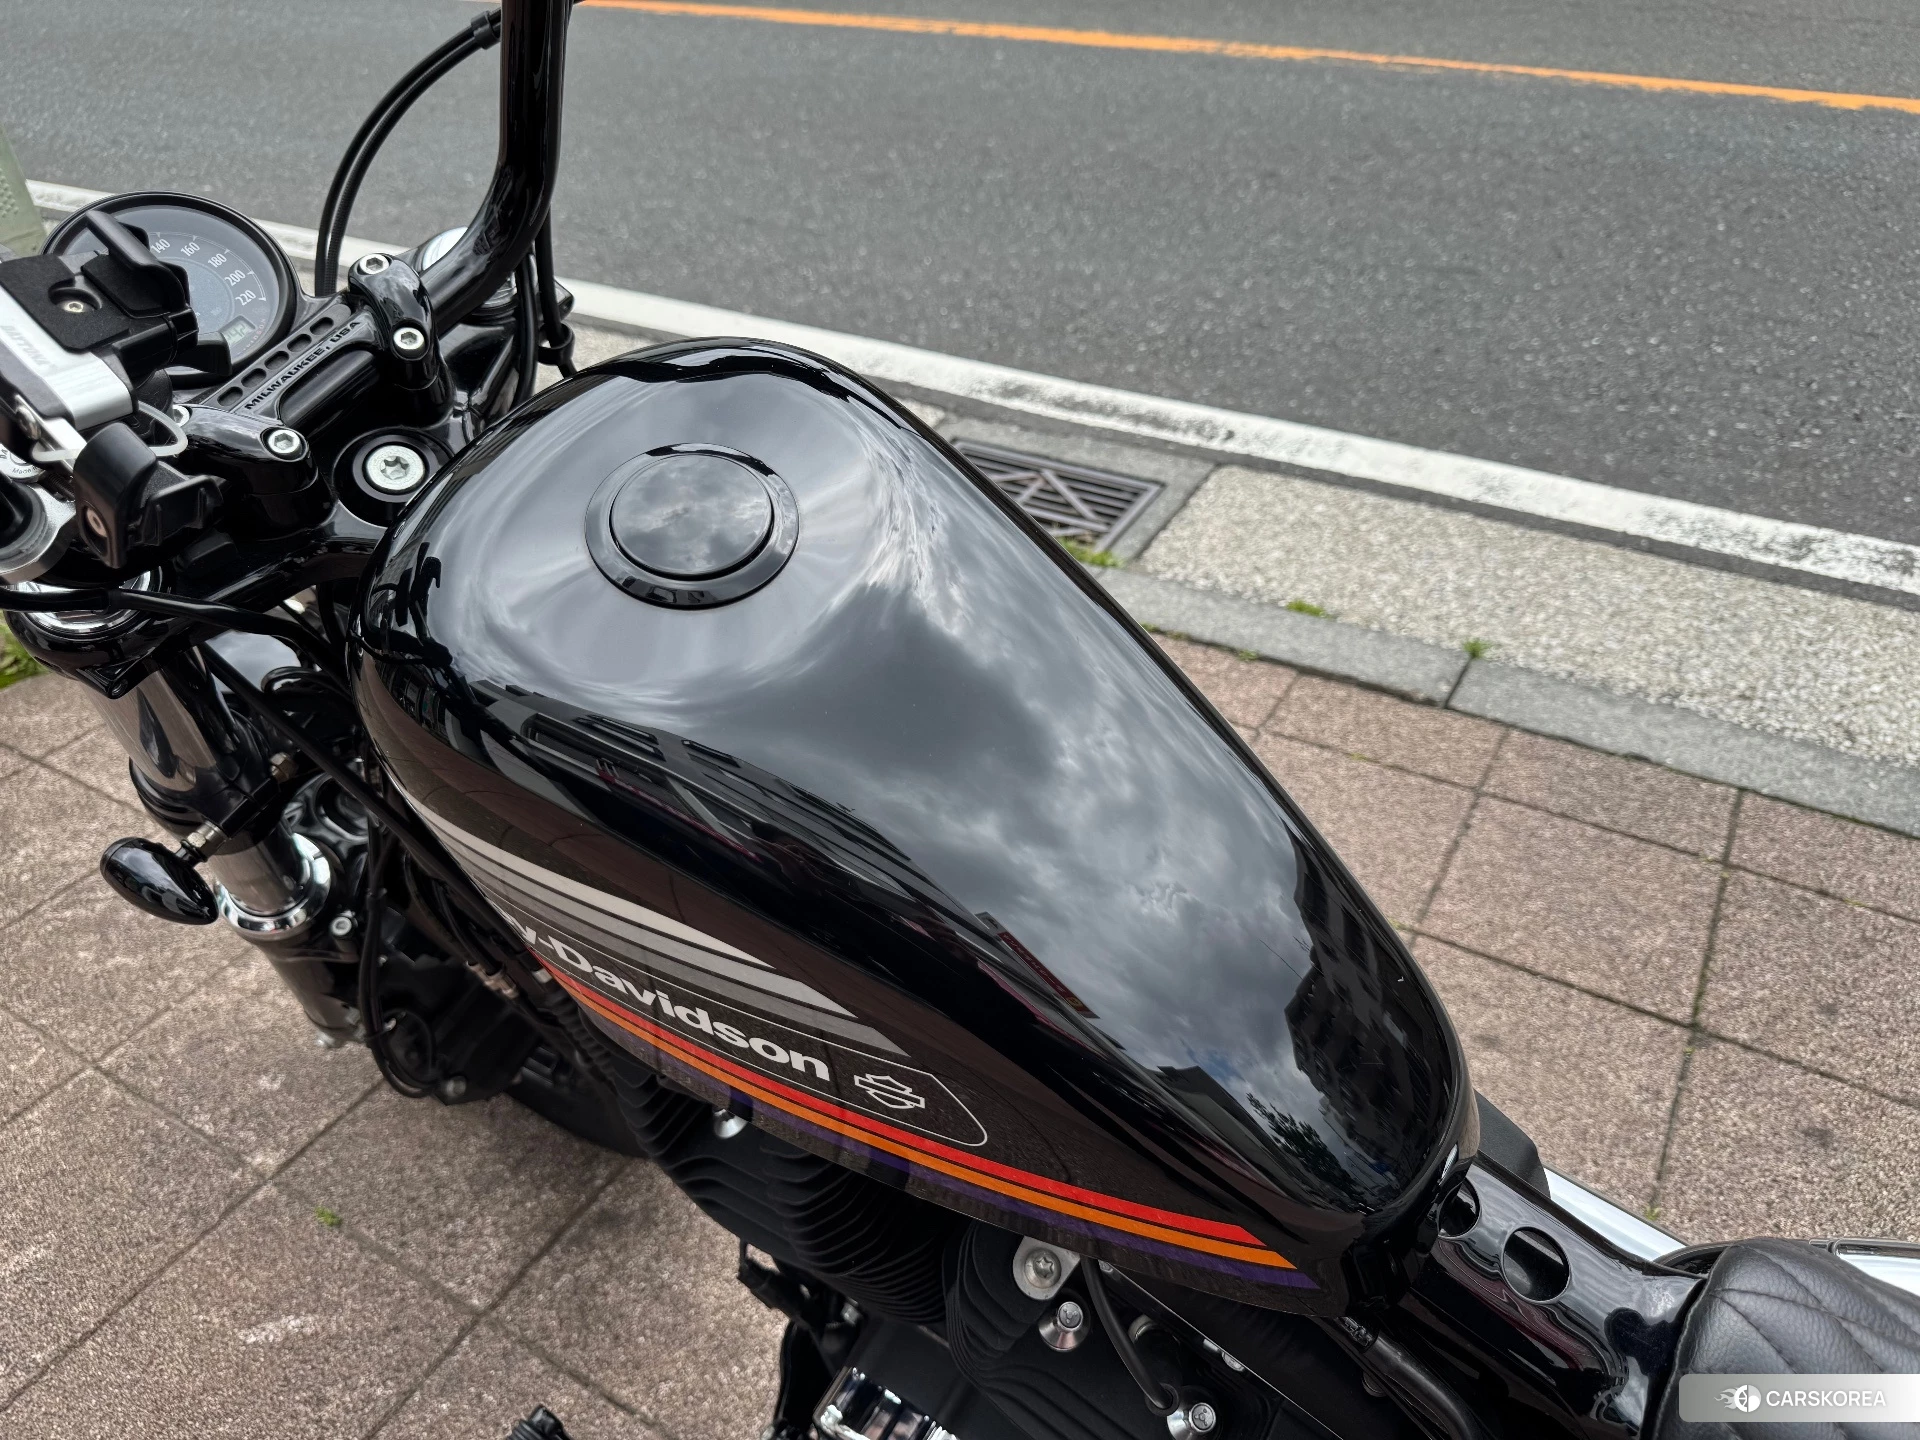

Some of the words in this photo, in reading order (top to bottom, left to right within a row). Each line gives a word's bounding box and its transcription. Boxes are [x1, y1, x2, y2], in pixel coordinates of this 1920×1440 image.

[150, 238, 171, 254] 140
[180, 241, 201, 257] 160
[207, 253, 227, 268] 180
[224, 269, 246, 287] 200
[234, 289, 257, 306] 220
[244, 346, 331, 410] MILWAUKEE,
[329, 321, 361, 343] USA
